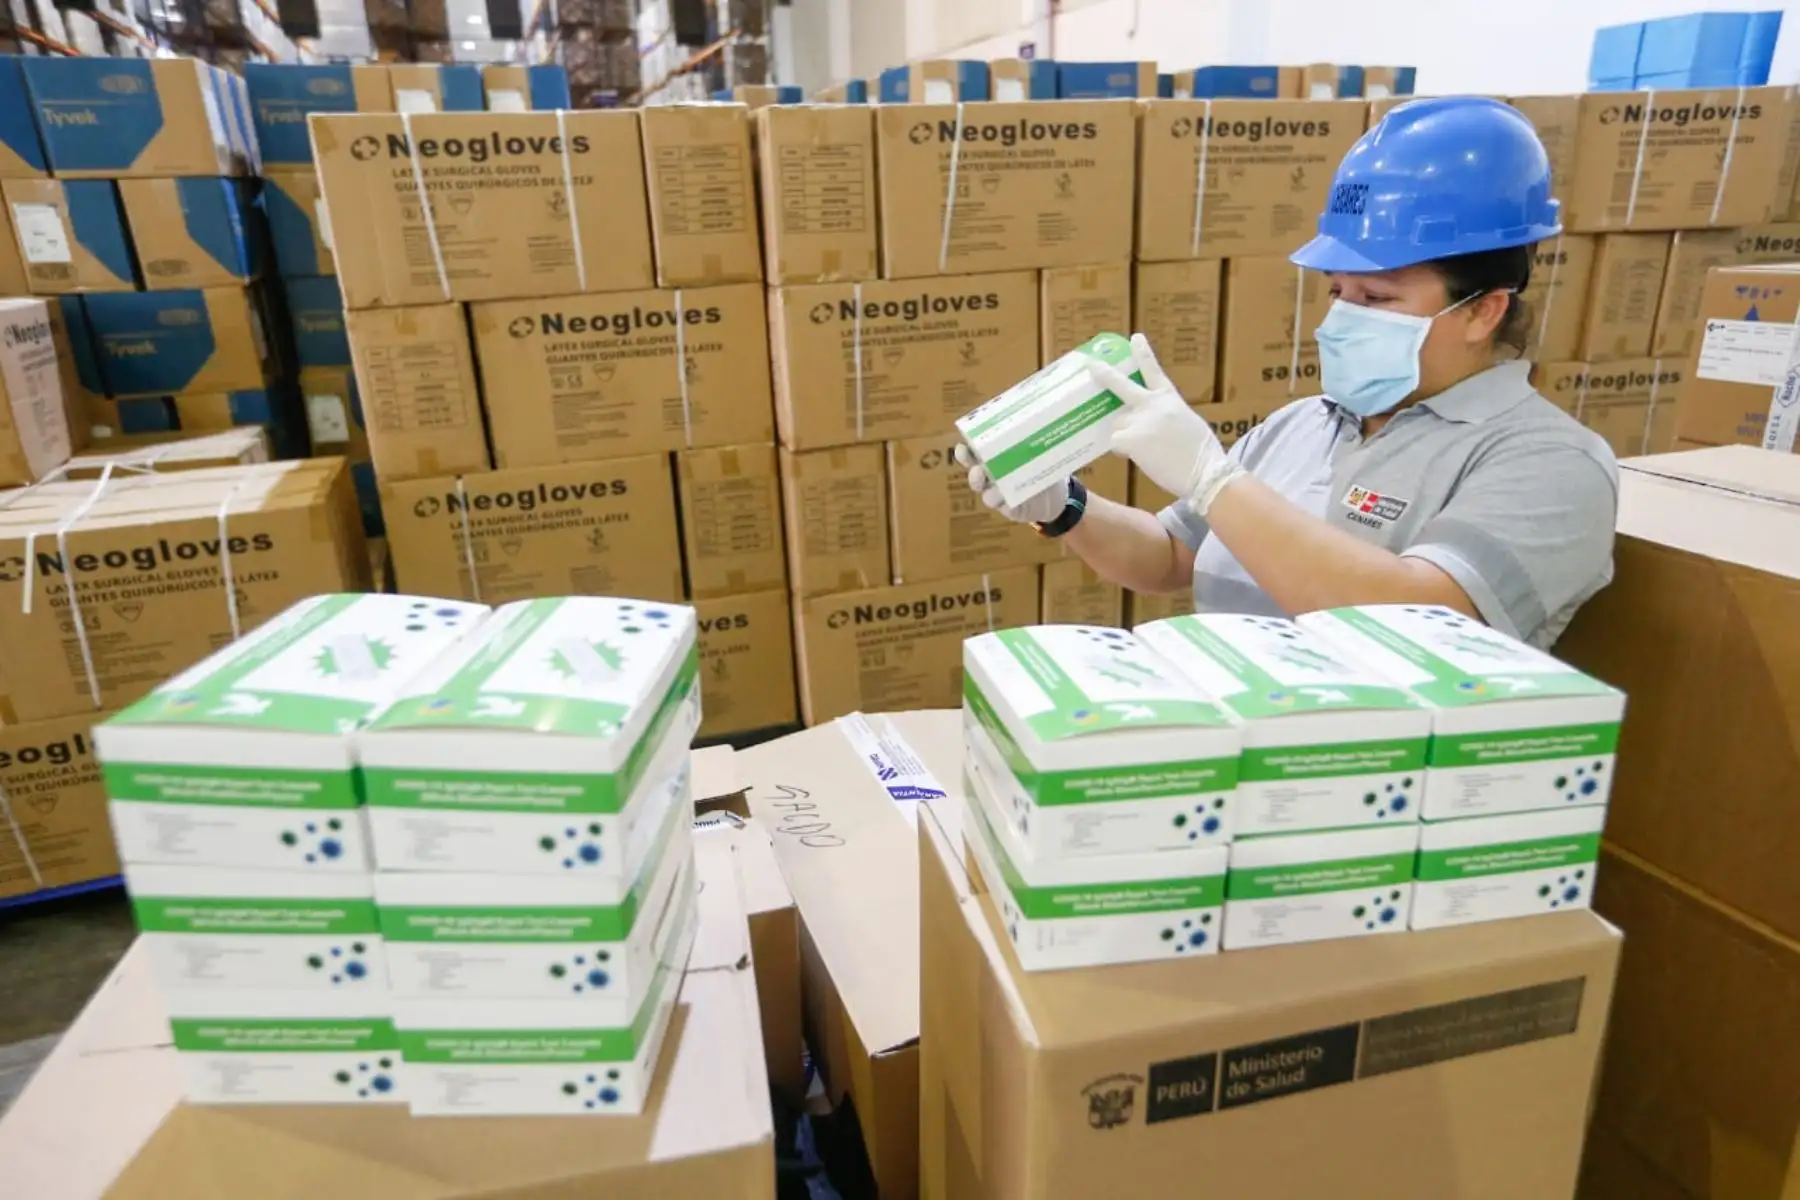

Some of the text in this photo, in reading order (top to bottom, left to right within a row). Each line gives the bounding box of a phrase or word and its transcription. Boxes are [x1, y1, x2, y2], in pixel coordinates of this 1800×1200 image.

[386, 132, 591, 163] Neogloves
[938, 119, 1098, 146] Neogloves
[392, 166, 430, 179] LATX
[541, 306, 722, 336] Neogloves
[840, 293, 1000, 321] Neogloves
[446, 478, 628, 514] Neogloves
[37, 533, 274, 577] Neogloves
[92, 573, 163, 588] SURGICAL
[166, 565, 219, 579] GLOVES
[854, 588, 1003, 624] Neogloves
[1228, 1045, 1324, 1078] Ministerio
[1157, 1077, 1209, 1104] PERÚ
[1226, 1066, 1306, 1099] de Salud
